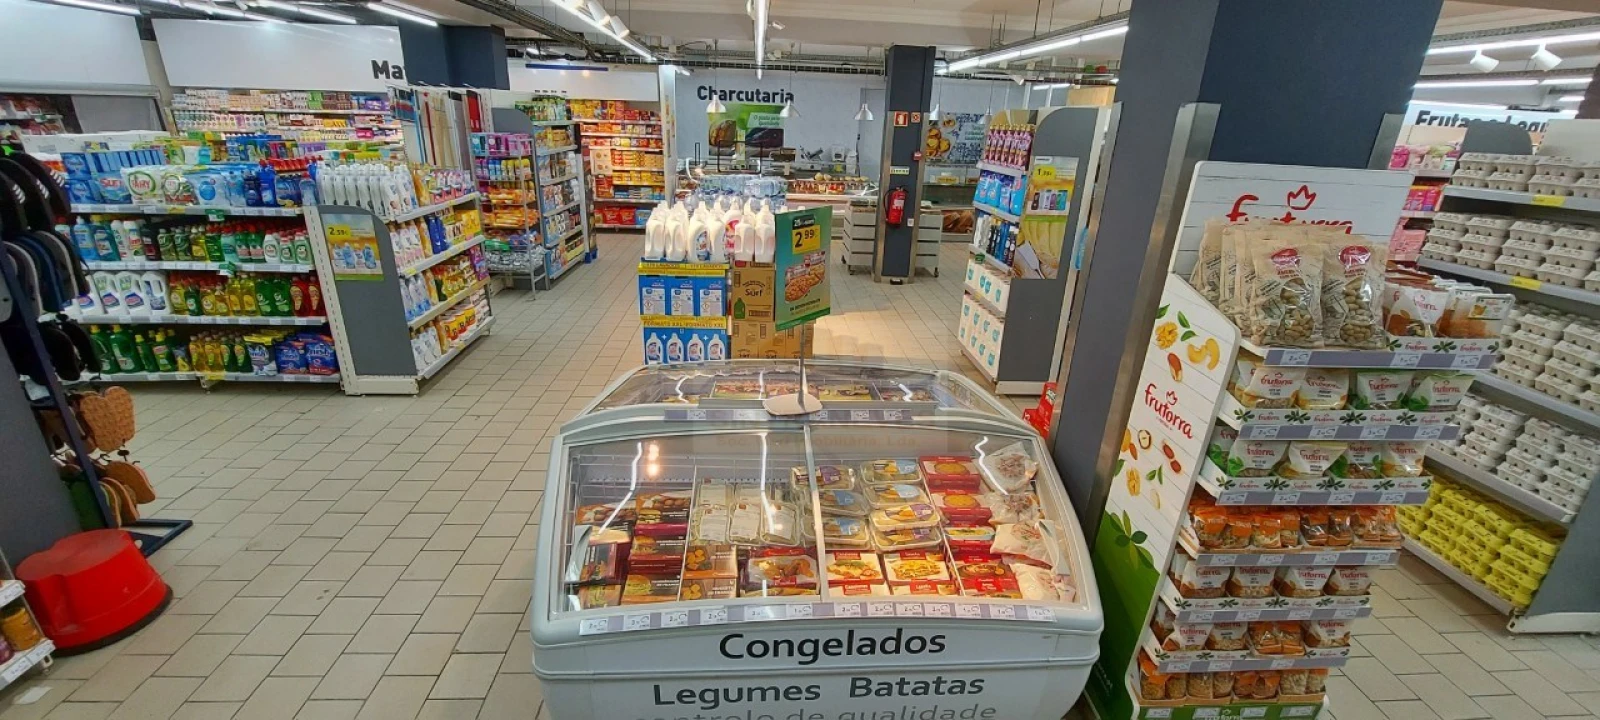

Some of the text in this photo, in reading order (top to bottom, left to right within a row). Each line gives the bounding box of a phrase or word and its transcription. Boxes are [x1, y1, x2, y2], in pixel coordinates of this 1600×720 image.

[697, 86, 795, 103] Charcutaria
[1415, 110, 1483, 128] Fruta
[1145, 383, 1193, 439] frutorra
[719, 628, 946, 665] Congelados
[653, 676, 985, 710] Legumes Batatas
